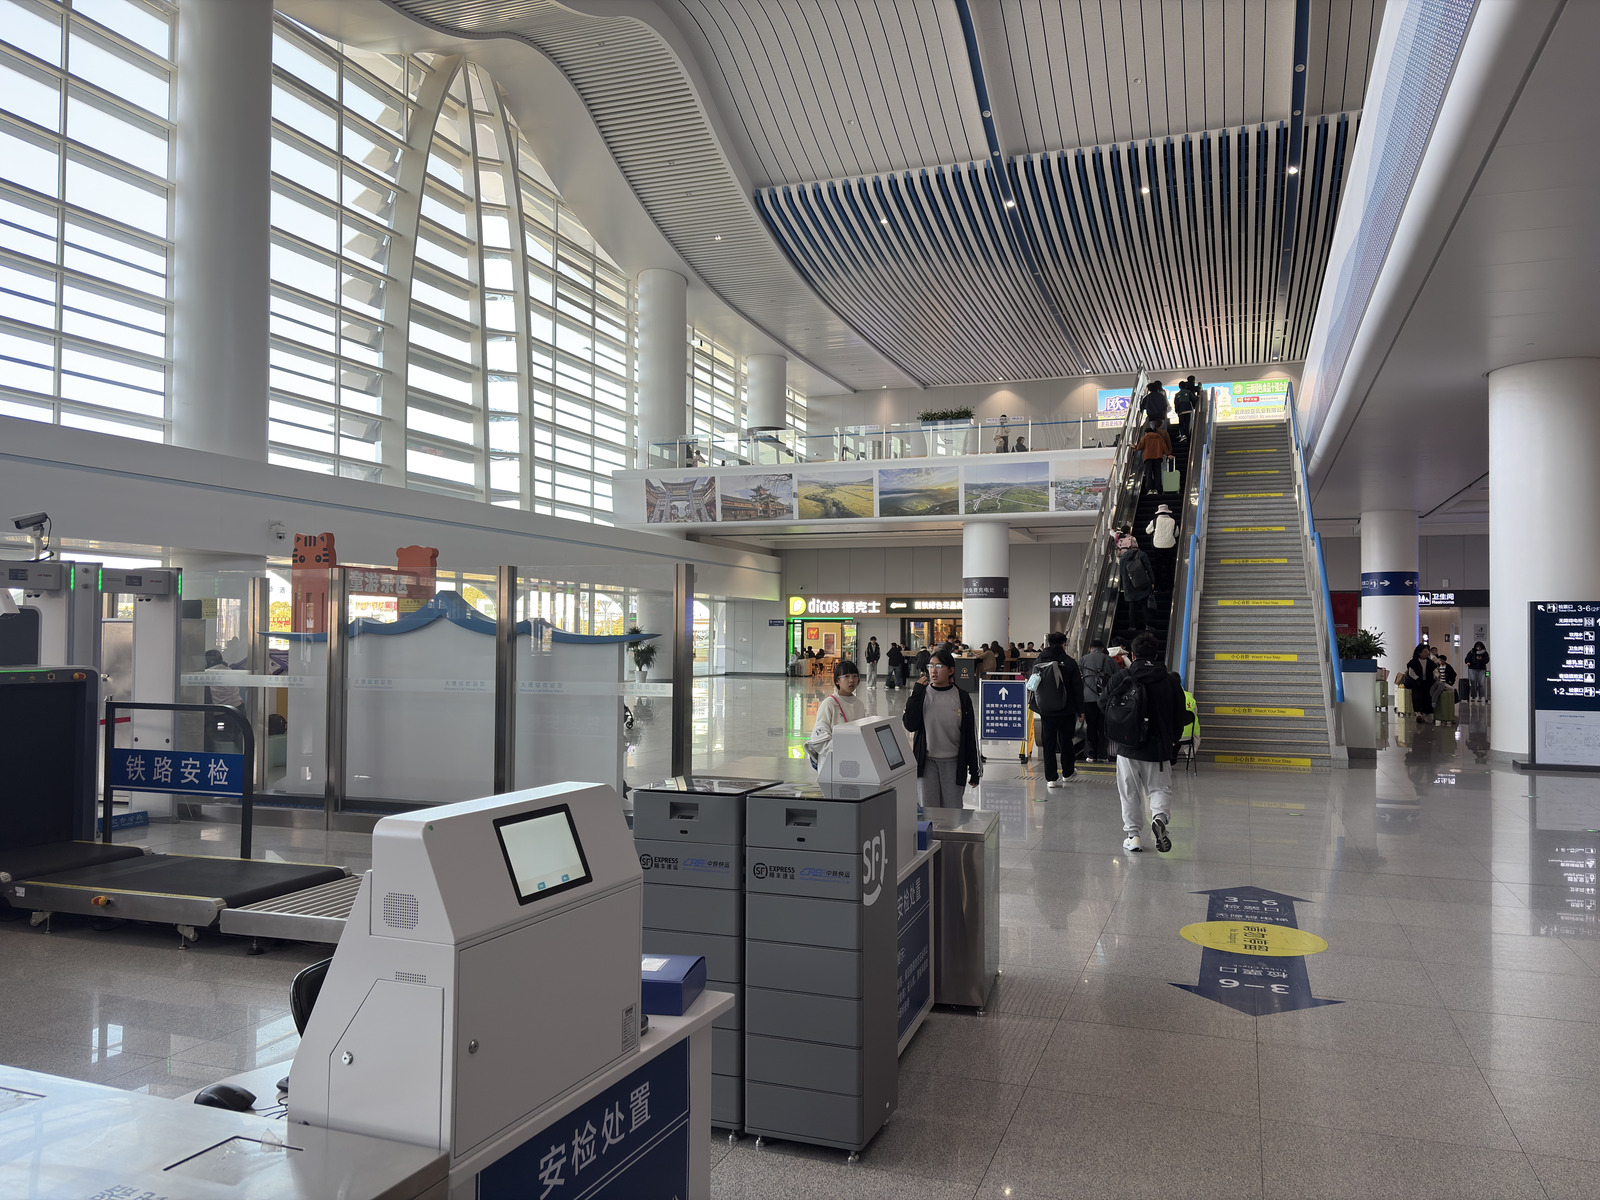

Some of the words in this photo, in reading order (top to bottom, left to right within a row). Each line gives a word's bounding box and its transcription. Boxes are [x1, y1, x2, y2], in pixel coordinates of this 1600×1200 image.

[807, 598, 840, 614] dicos
[841, 600, 881, 614] 德克士
[125, 755, 230, 786] 铁路安检
[826, 870, 850, 878] 中铁快运
[897, 877, 921, 921] 安检处置
[538, 1081, 651, 1200] 安检处置
